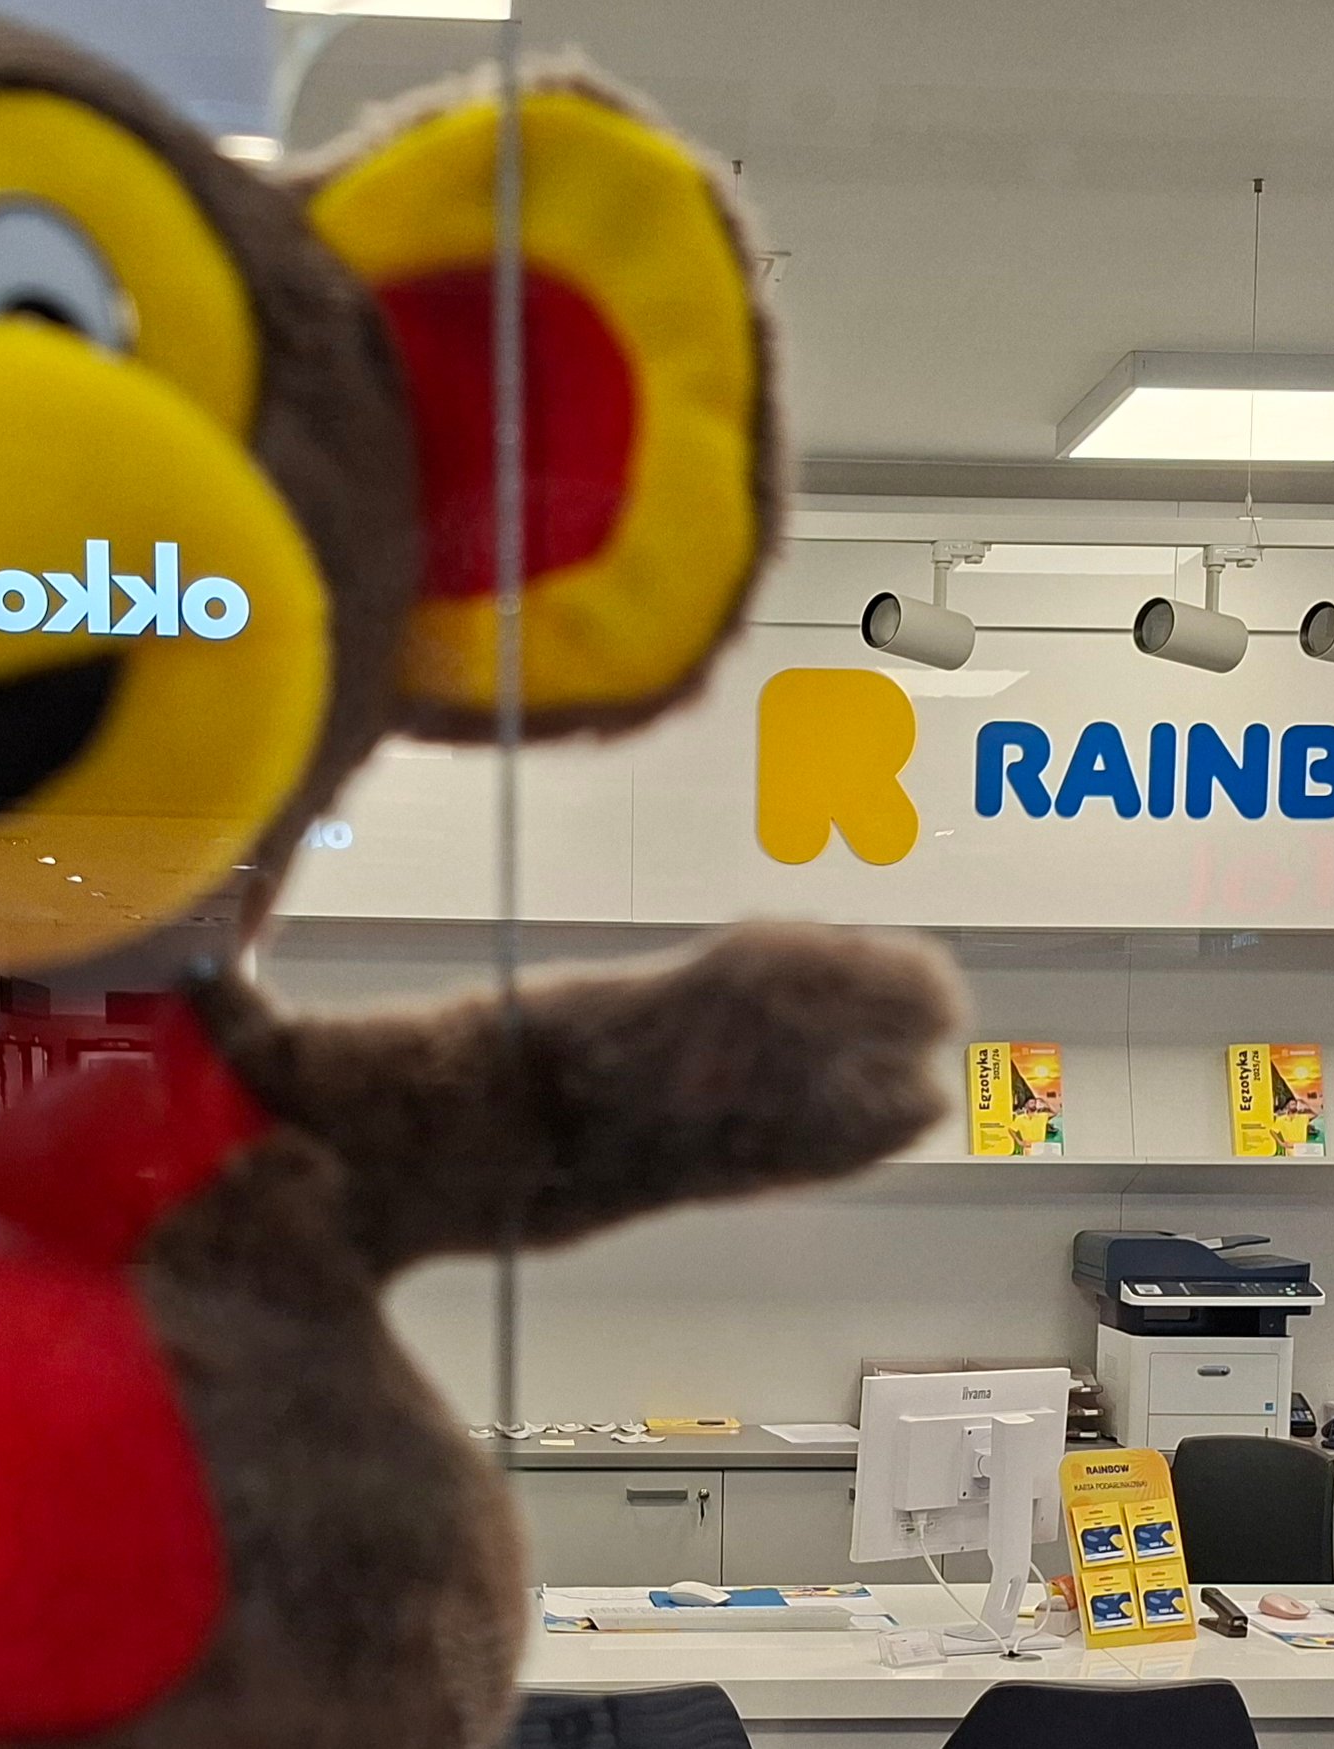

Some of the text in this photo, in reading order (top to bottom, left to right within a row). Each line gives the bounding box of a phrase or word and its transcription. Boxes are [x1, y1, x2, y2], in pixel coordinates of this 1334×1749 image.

[976, 1048, 992, 1111] Egzotyka
[1236, 1050, 1252, 1112] Egzotyka
[1085, 1464, 1130, 1475] RAINBOW
